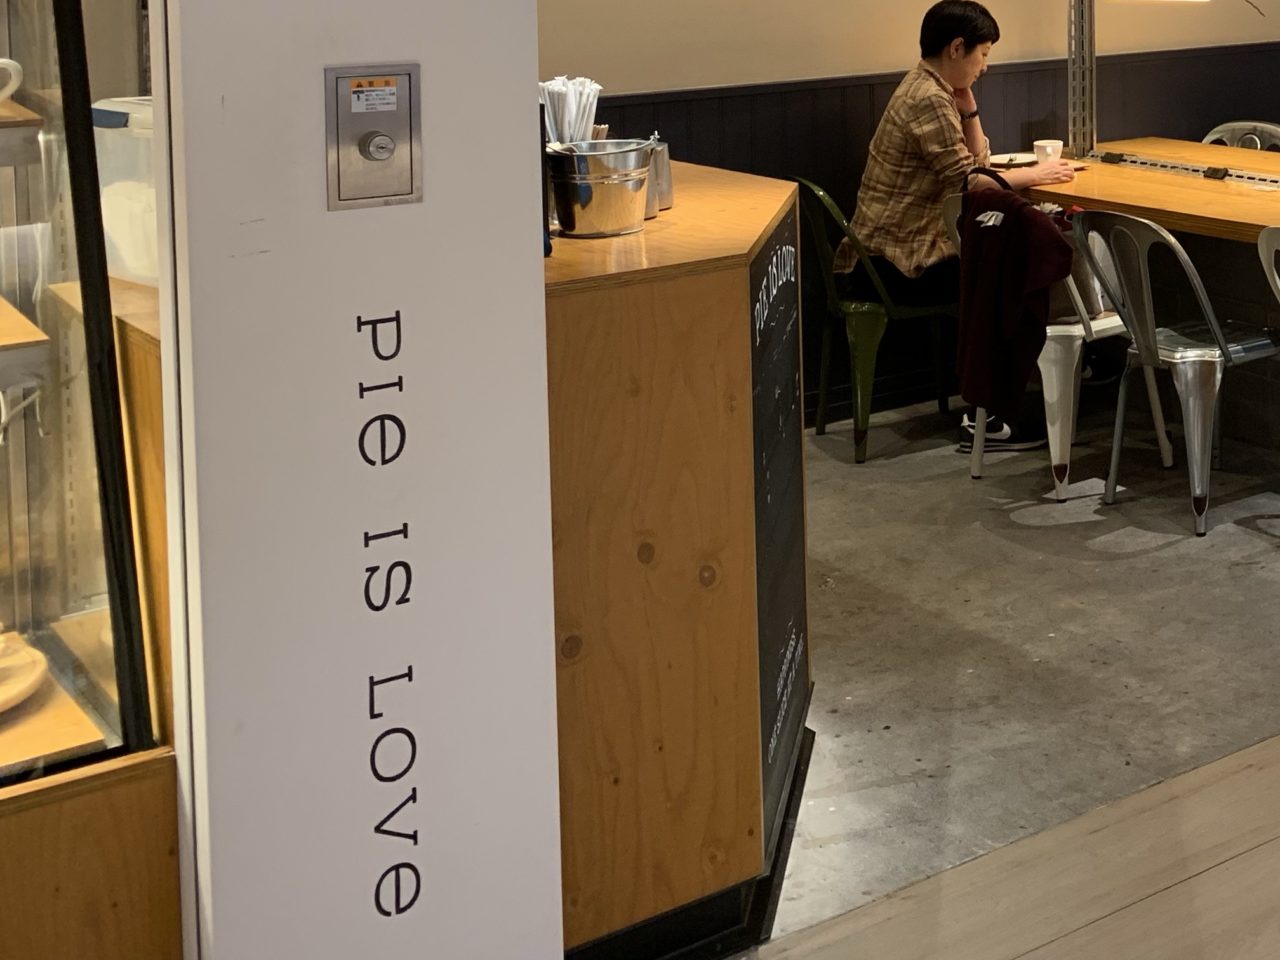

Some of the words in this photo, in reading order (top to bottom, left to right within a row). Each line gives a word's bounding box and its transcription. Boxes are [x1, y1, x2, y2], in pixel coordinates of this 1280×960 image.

[755, 276, 769, 347] PIE
[778, 245, 795, 287] LOVE
[363, 522, 413, 612] IS
